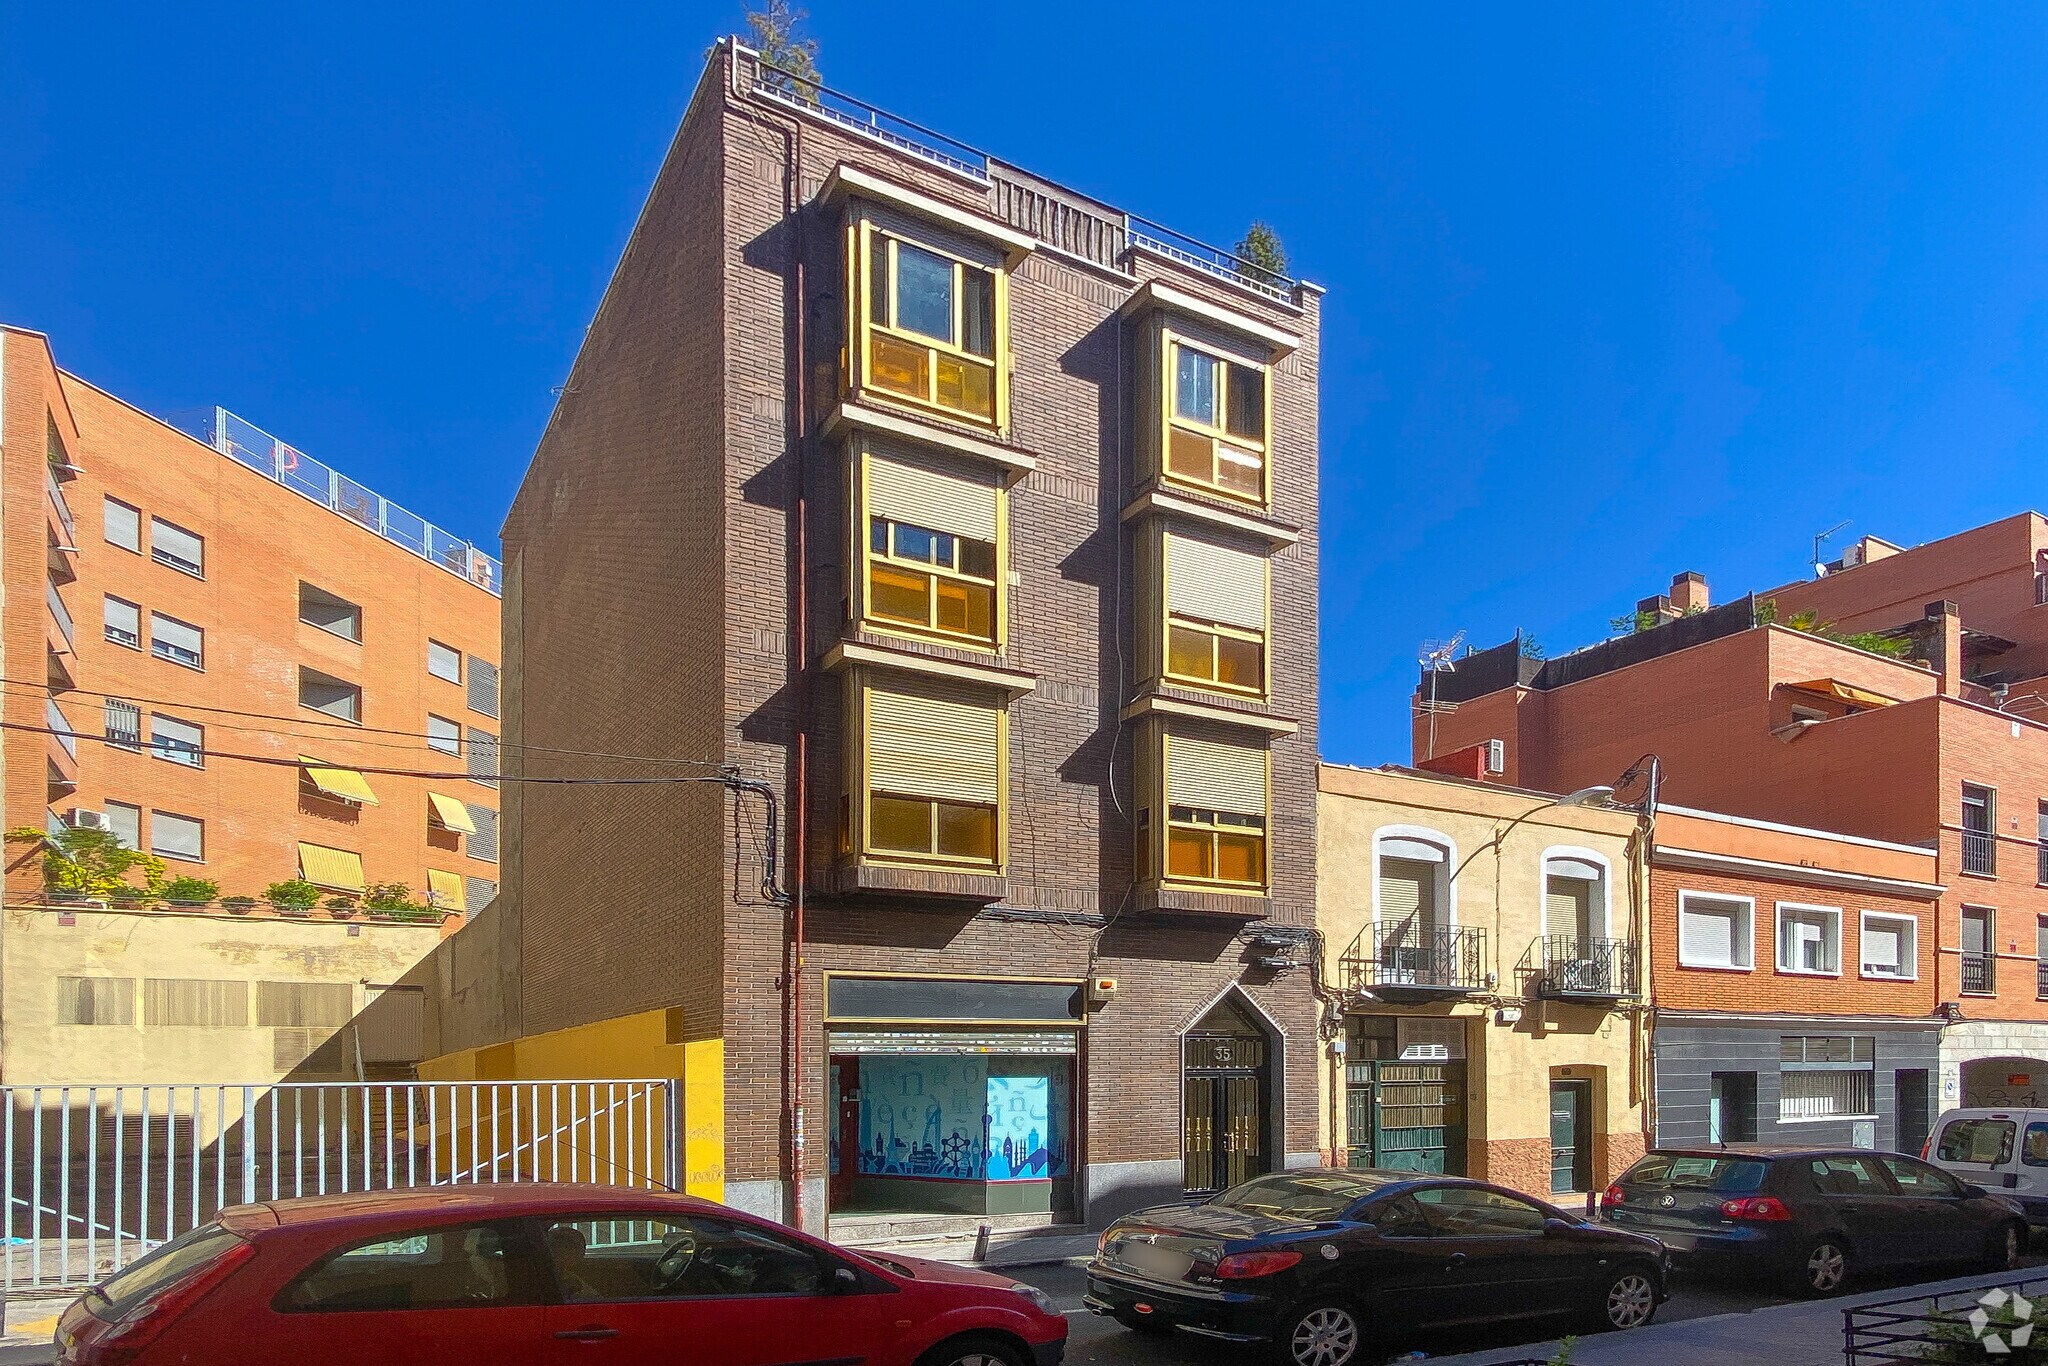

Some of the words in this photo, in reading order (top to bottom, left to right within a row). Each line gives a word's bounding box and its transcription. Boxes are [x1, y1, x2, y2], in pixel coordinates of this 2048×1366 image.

[1215, 1048, 1230, 1060] 35
[1008, 1090, 1027, 1112] ñ
[1011, 1115, 1025, 1132] ç
